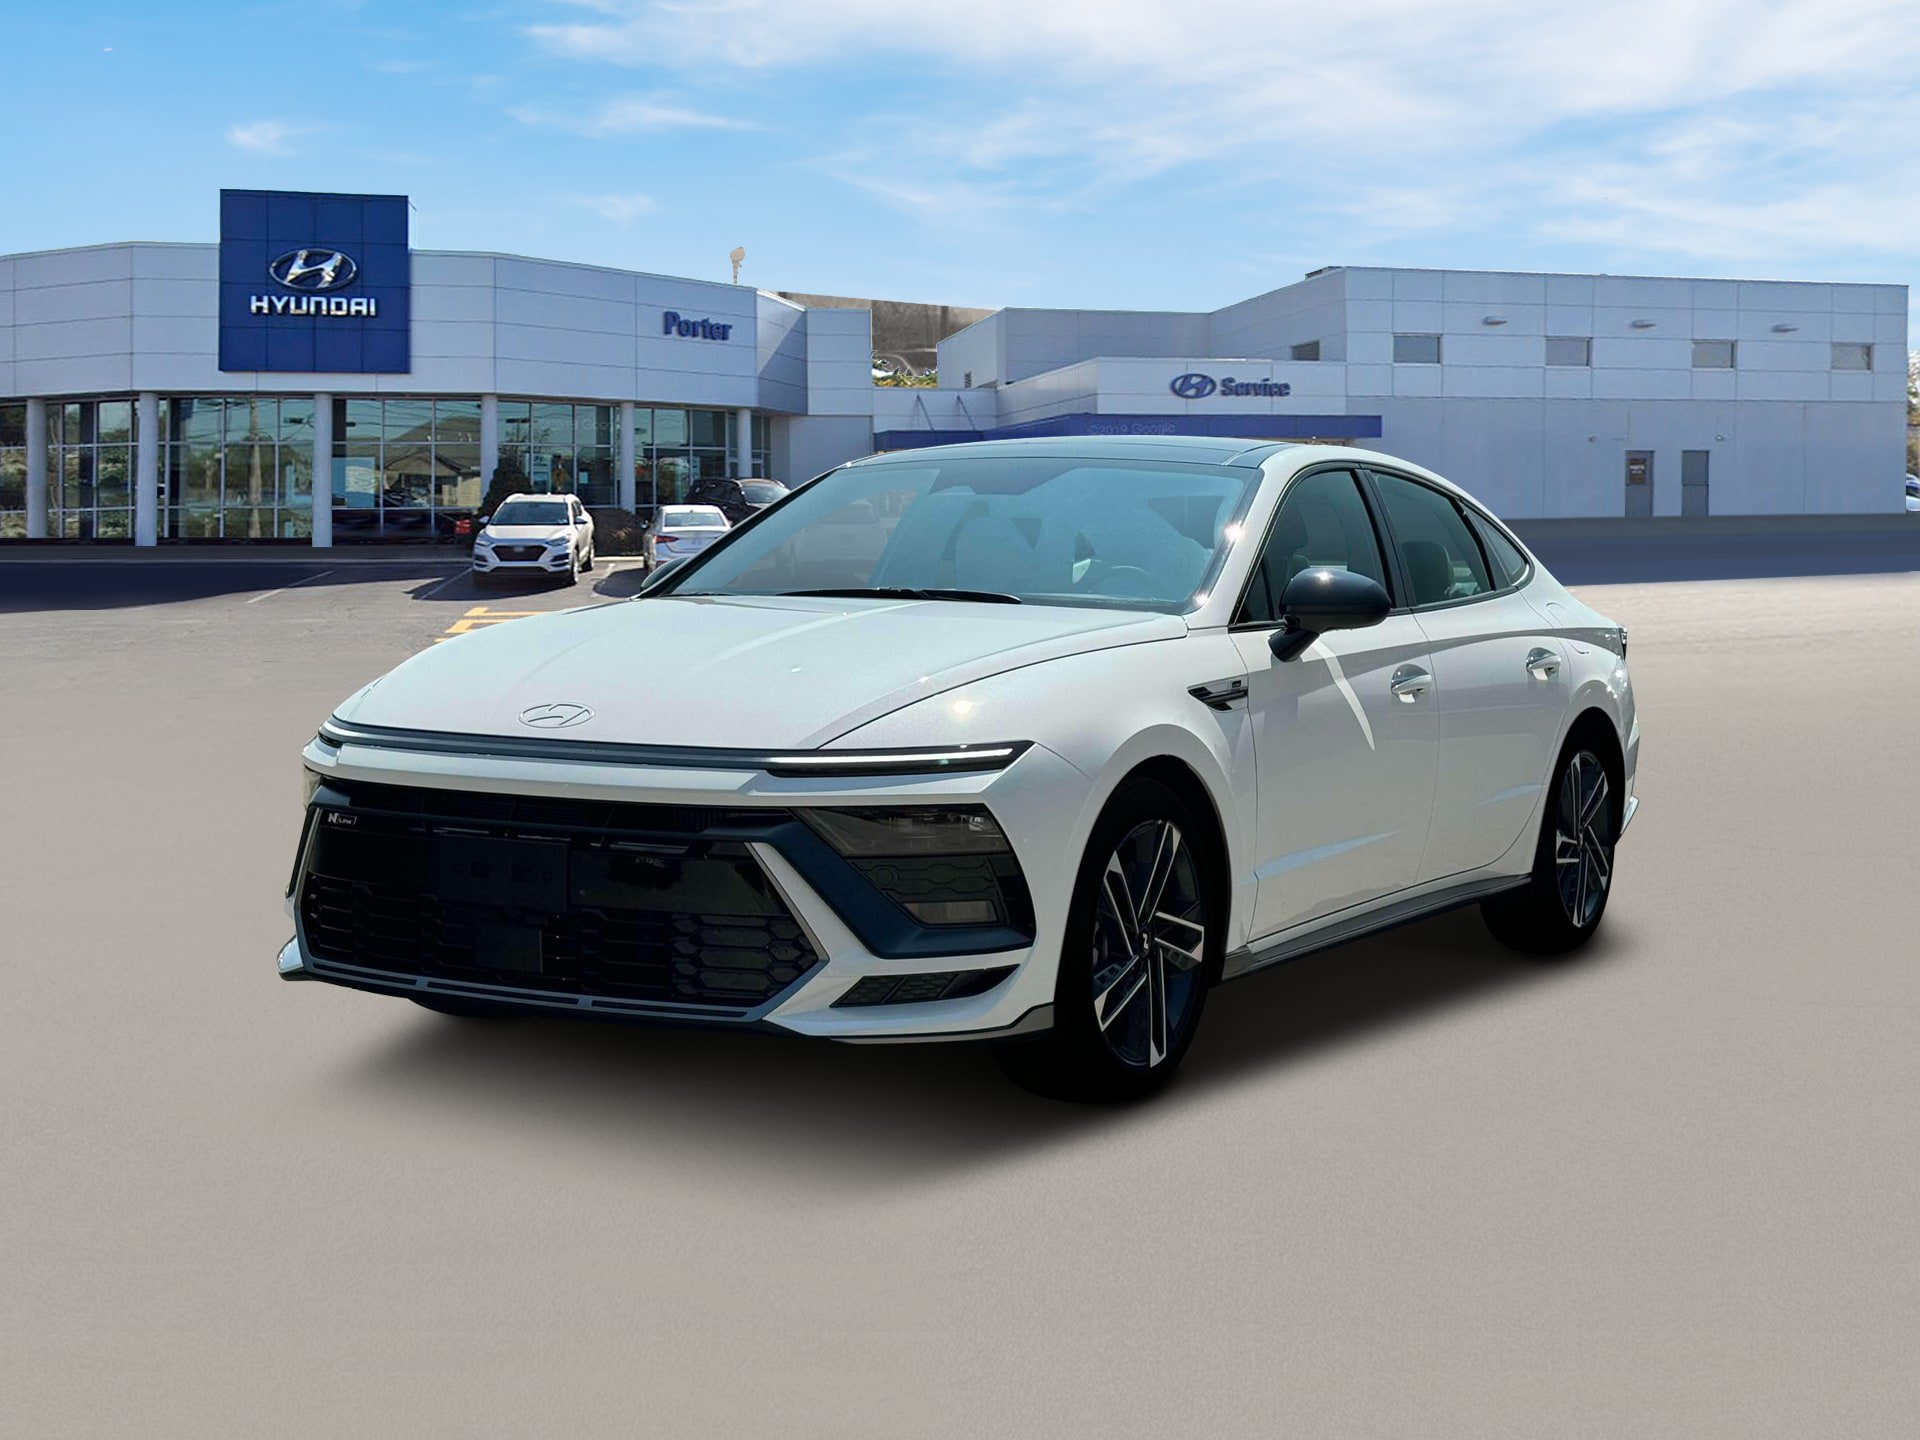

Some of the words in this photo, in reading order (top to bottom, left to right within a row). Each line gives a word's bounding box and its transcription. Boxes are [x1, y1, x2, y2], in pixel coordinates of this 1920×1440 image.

[250, 295, 377, 317] HYUNDAI
[663, 310, 733, 342] Porter
[1220, 376, 1291, 397] Service
